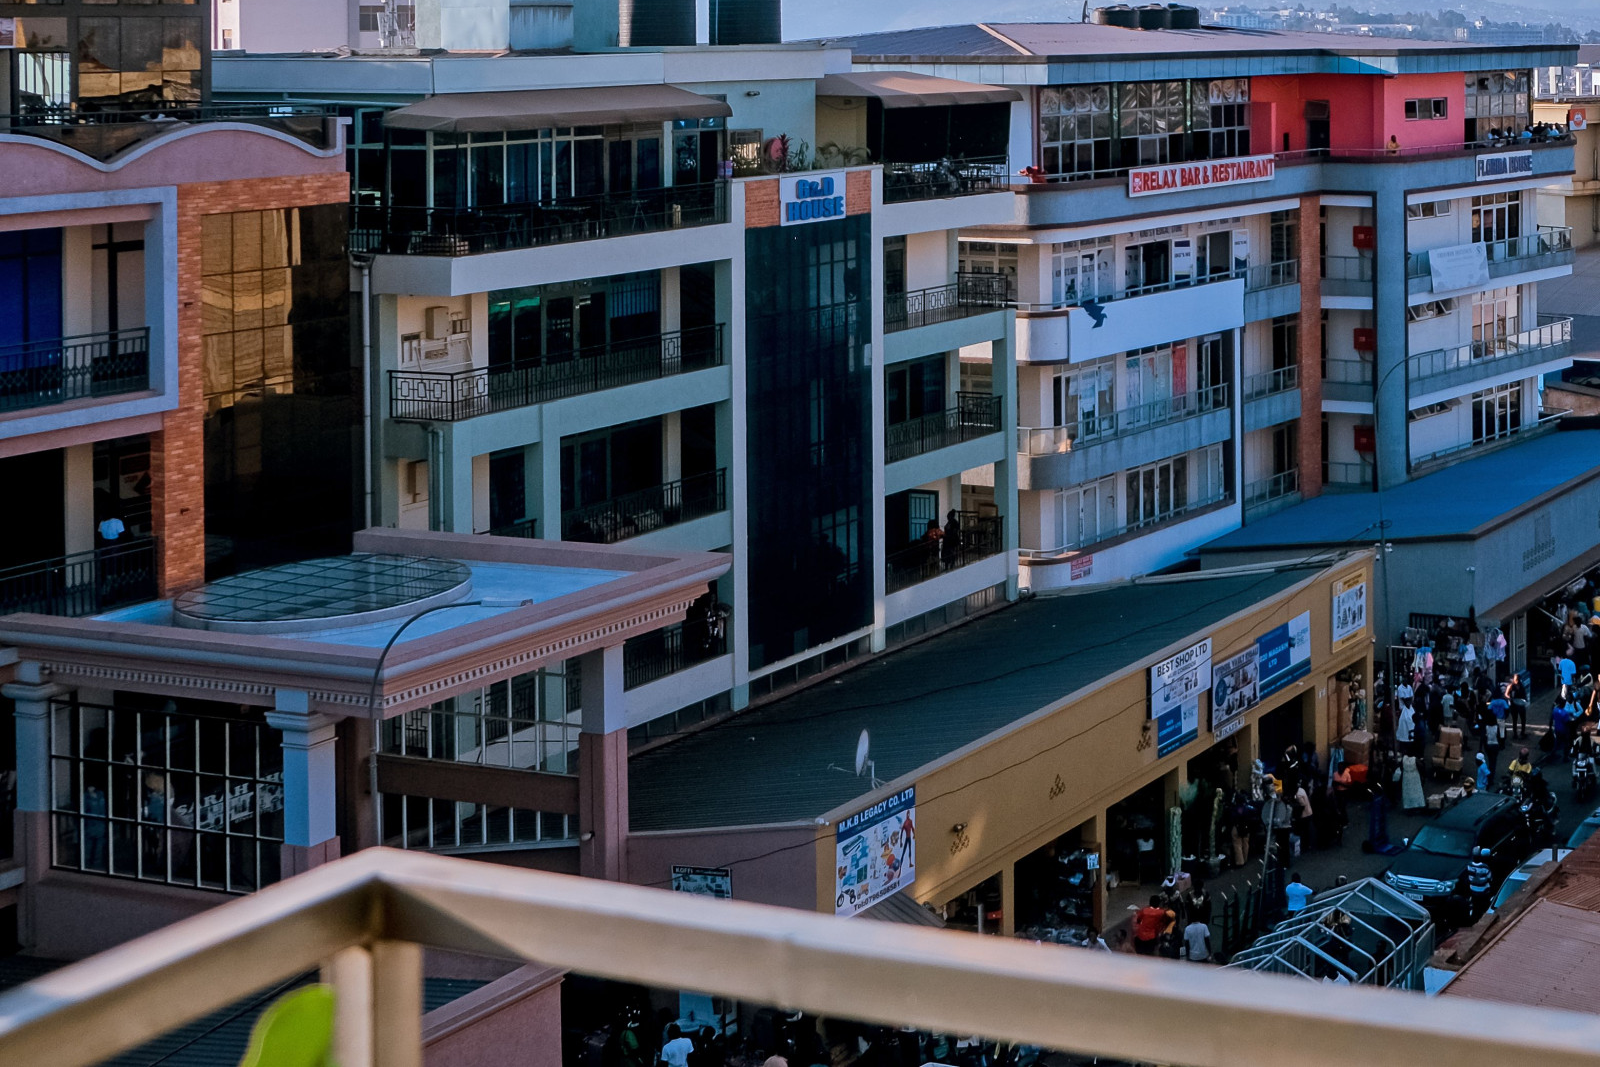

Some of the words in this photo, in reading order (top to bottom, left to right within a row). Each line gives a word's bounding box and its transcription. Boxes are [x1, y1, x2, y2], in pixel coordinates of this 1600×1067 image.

[1143, 169, 1178, 191] RELAX
[1180, 166, 1201, 187] BAR
[1202, 165, 1210, 184] &
[1211, 158, 1275, 183] RESTAURANT
[1508, 155, 1533, 173] HOUSE
[795, 176, 835, 199] G&D
[785, 195, 845, 222] HOUSE
[1156, 659, 1174, 678] BEST
[1175, 648, 1195, 670] SHOP
[1195, 642, 1208, 658] LTD
[839, 815, 859, 833] M.K.B
[860, 800, 888, 823] LEGACY
[888, 795, 900, 808] CO.
[901, 787, 914, 802] LTD
